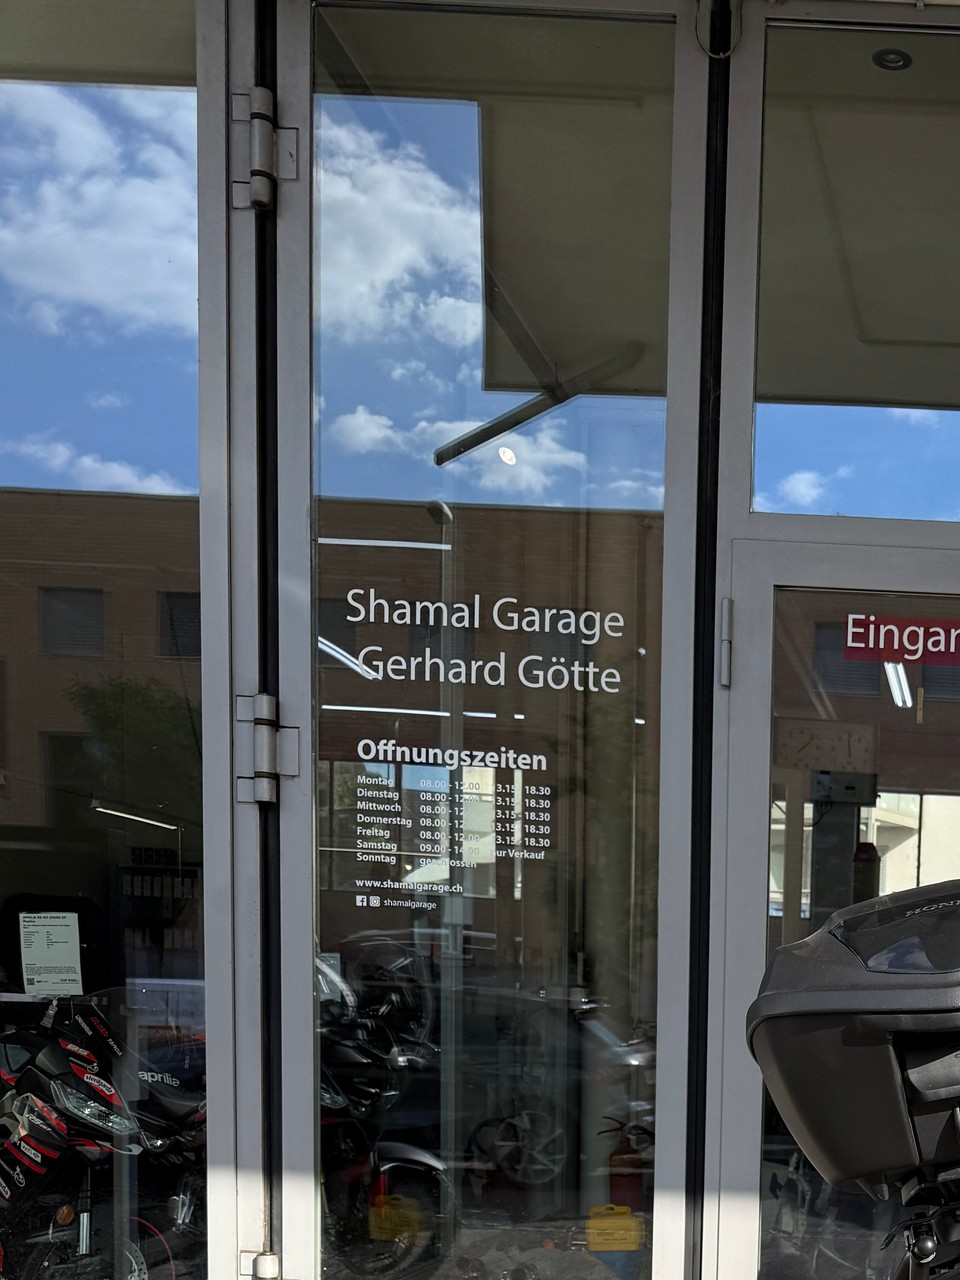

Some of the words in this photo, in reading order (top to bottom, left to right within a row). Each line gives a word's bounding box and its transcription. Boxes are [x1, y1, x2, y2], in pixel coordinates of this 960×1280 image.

[346, 588, 480, 629] Shamal
[492, 597, 625, 645] Garage
[357, 646, 506, 686] Gerhard
[518, 655, 622, 693] Götte
[357, 775, 394, 788] Montag
[420, 779, 446, 789] 08.00
[525, 786, 551, 795] 18.30
[357, 788, 399, 801] Dienstag
[420, 792, 446, 801] 08.00
[525, 799, 551, 808] 18.30
[357, 801, 402, 812] Mittwoch
[420, 805, 446, 815] 08.00
[525, 812, 551, 821] 18.30
[357, 814, 412, 828] Donnerstag
[420, 818, 446, 828] 08.00
[525, 825, 551, 834] 18.30
[357, 827, 390, 839] Freitag
[420, 831, 446, 841] 08.00
[525, 838, 551, 847] 18.30
[357, 840, 397, 852] Samstag
[420, 844, 446, 853] 09.00
[508, 849, 545, 860] Verkauf
[357, 852, 396, 865] Sonntag
[419, 856, 477, 869] geschossen
[355, 879, 463, 894] www.shamalgarage.ch
[384, 898, 437, 911] shamalgarage
[138, 1071, 180, 1087] aprilia
